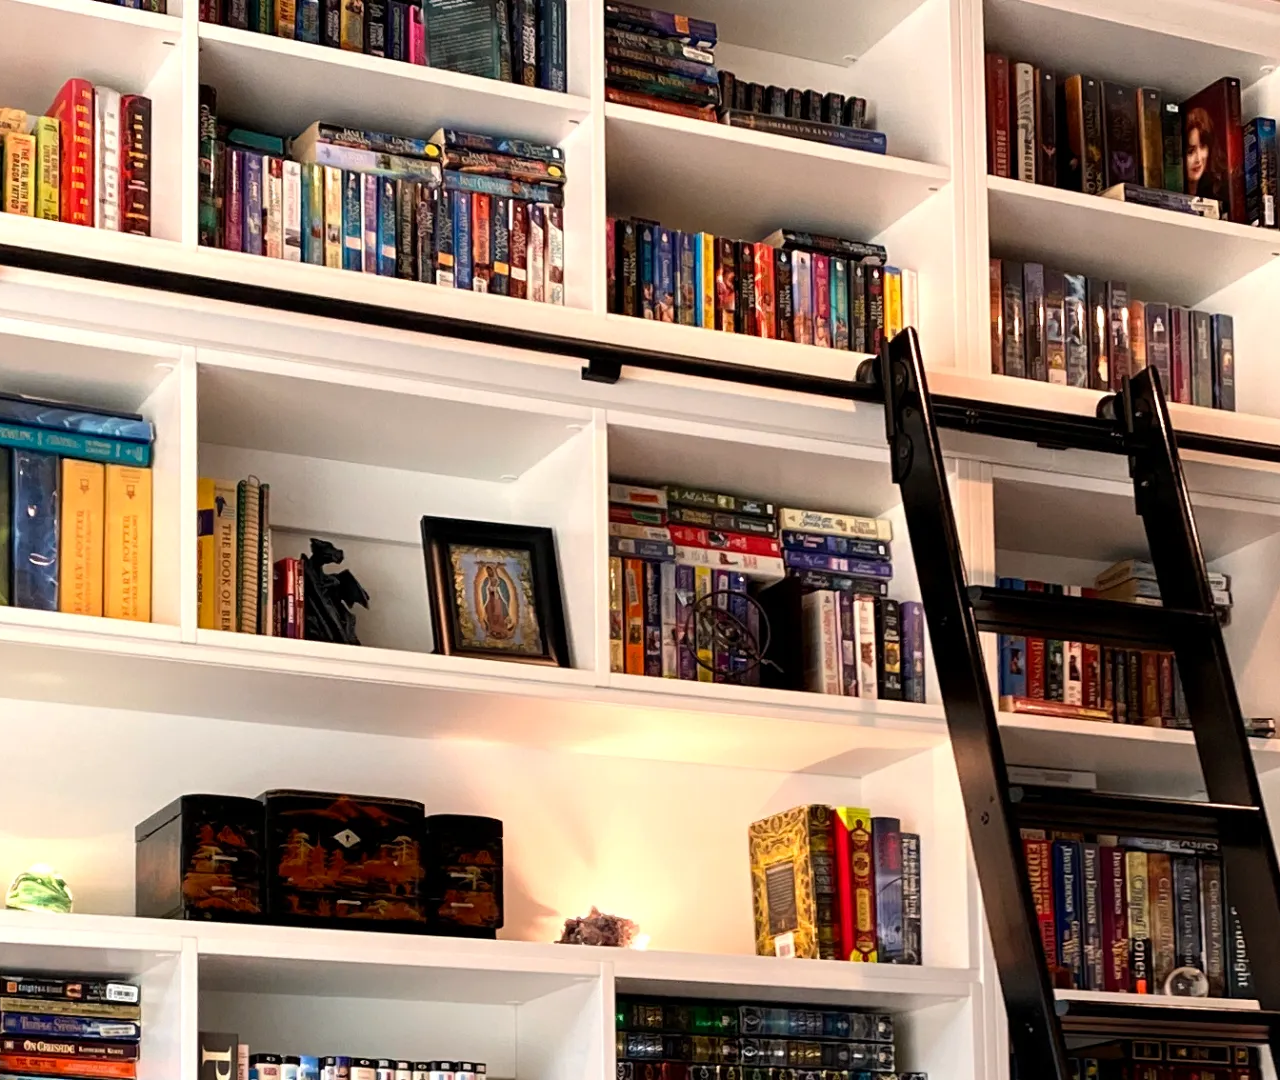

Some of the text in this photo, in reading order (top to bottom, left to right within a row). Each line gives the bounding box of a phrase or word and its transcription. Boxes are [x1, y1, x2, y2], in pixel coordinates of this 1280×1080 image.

[222, 524, 231, 609] THE BOOK OF
